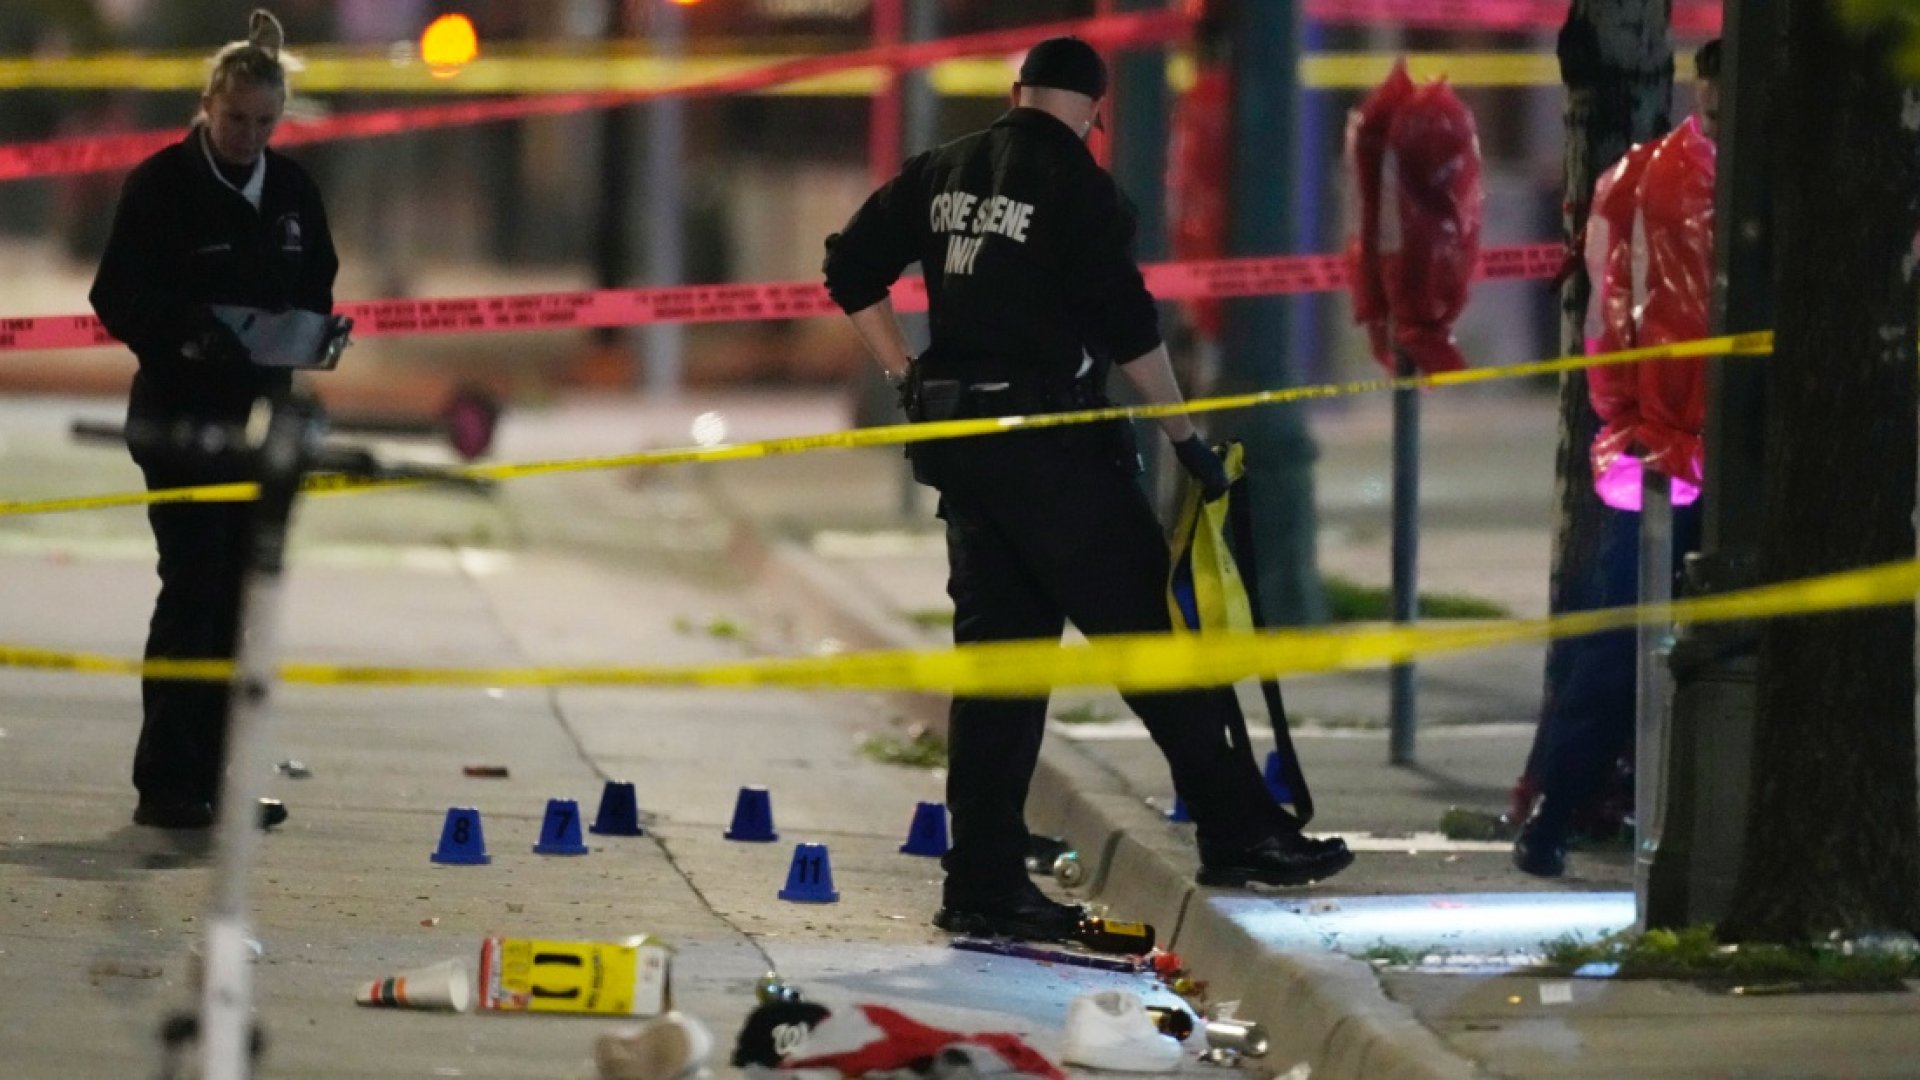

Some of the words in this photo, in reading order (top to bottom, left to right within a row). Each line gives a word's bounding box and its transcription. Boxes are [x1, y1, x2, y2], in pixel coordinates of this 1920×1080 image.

[972, 195, 1034, 243] SENE
[452, 816, 469, 844] 8
[553, 810, 572, 839] 7
[798, 854, 821, 885] 11
